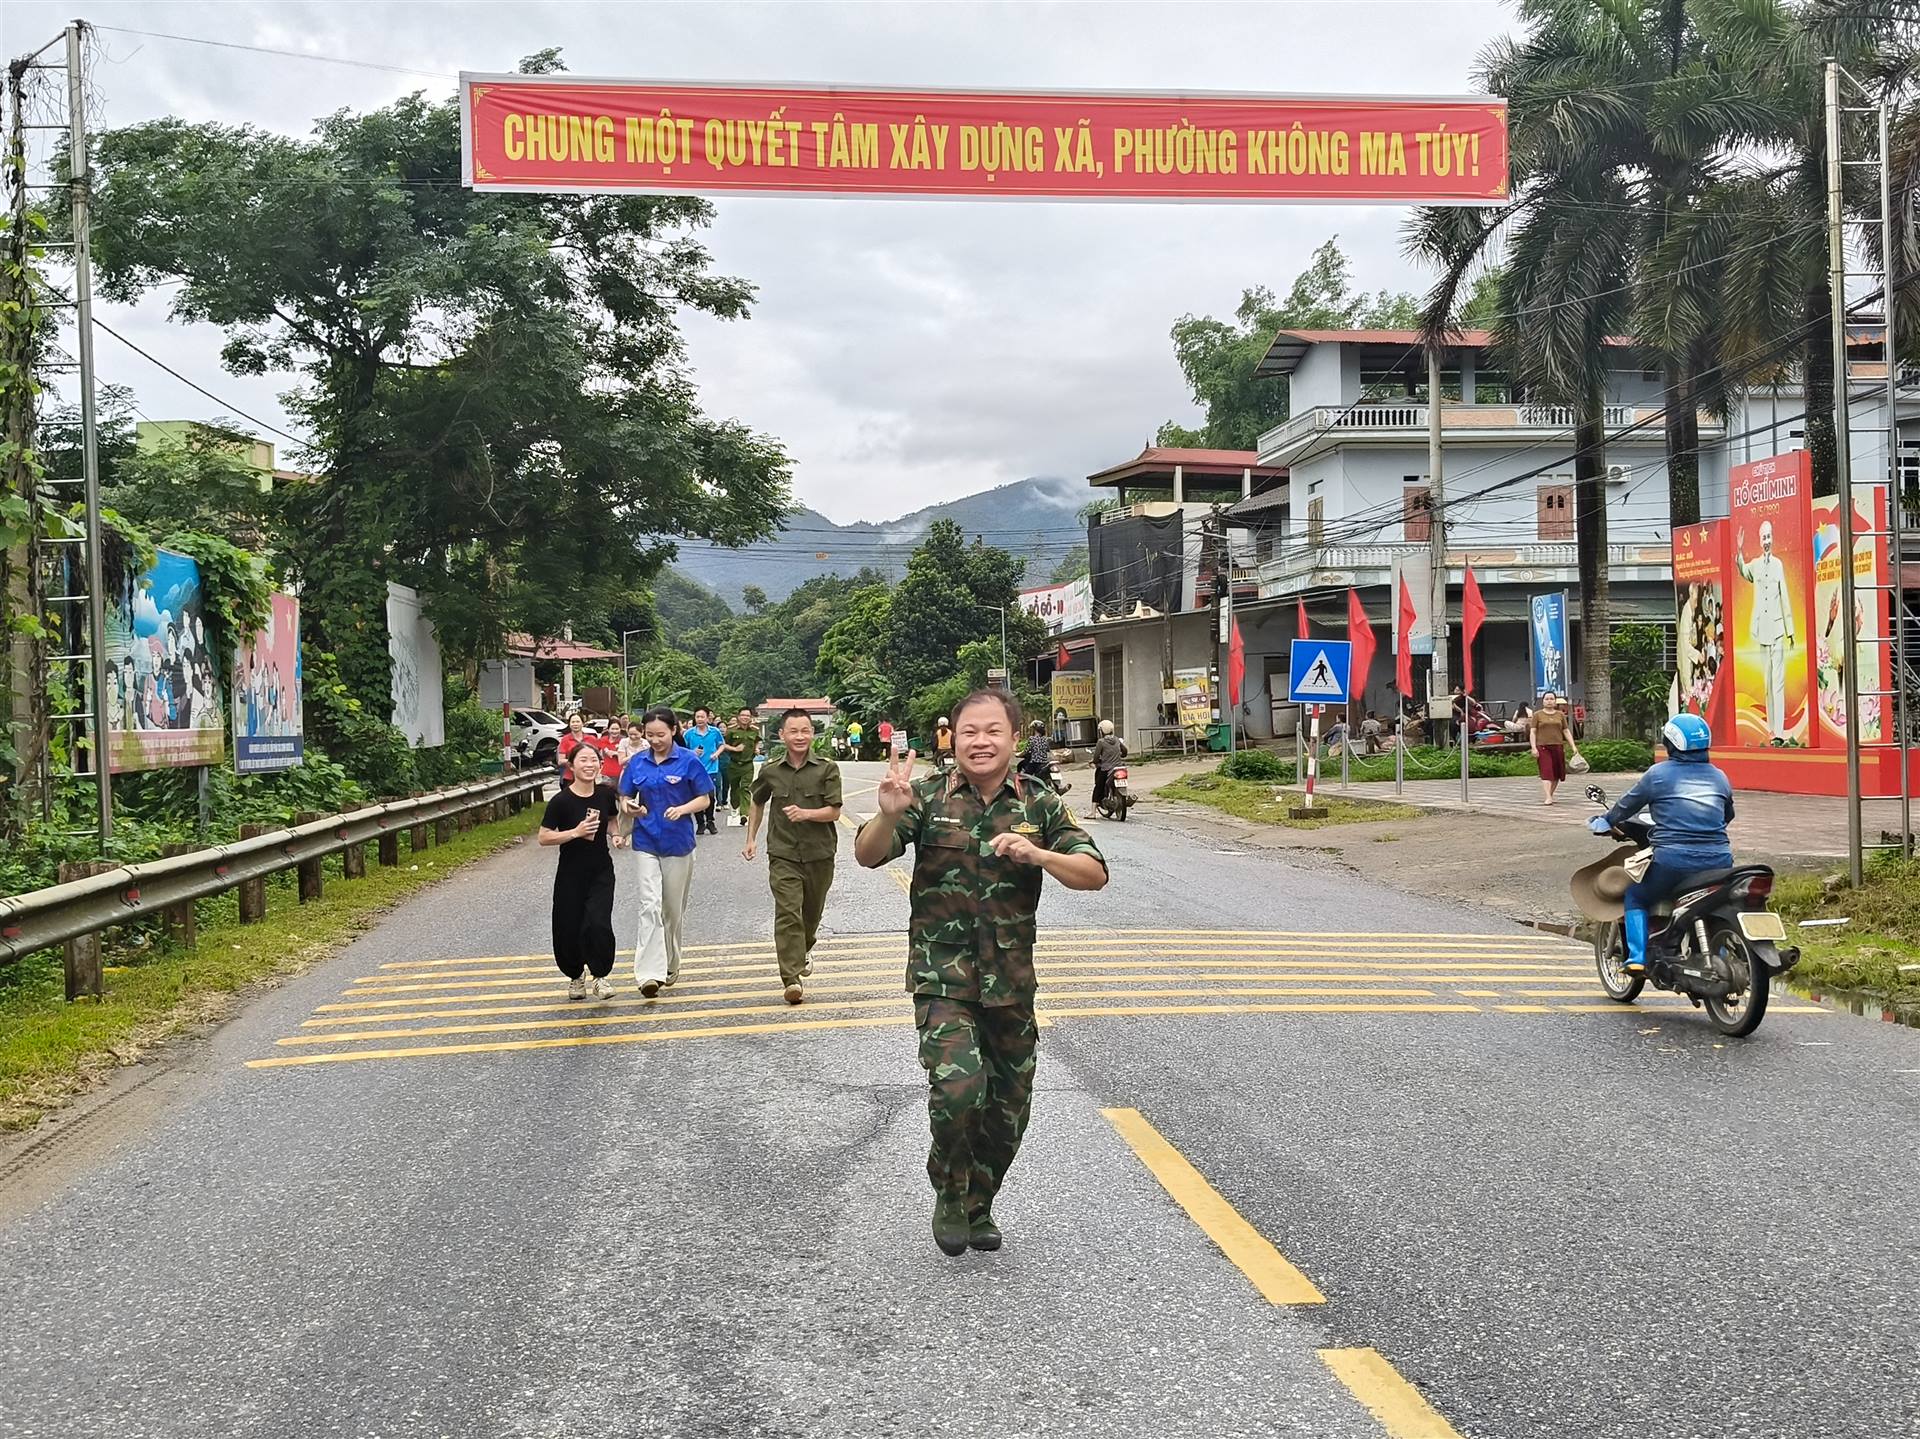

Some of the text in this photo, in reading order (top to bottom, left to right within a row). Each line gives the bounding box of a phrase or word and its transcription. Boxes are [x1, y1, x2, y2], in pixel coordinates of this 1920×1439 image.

[504, 107, 1479, 181] CHUNG MỘT QUYẾT TÂM XÂY DỰNG XÃ, PHƯỜNG KHÔNG MA TÚY!
[1751, 476, 1769, 503] CHÍ
[1769, 475, 1797, 500] MINH
